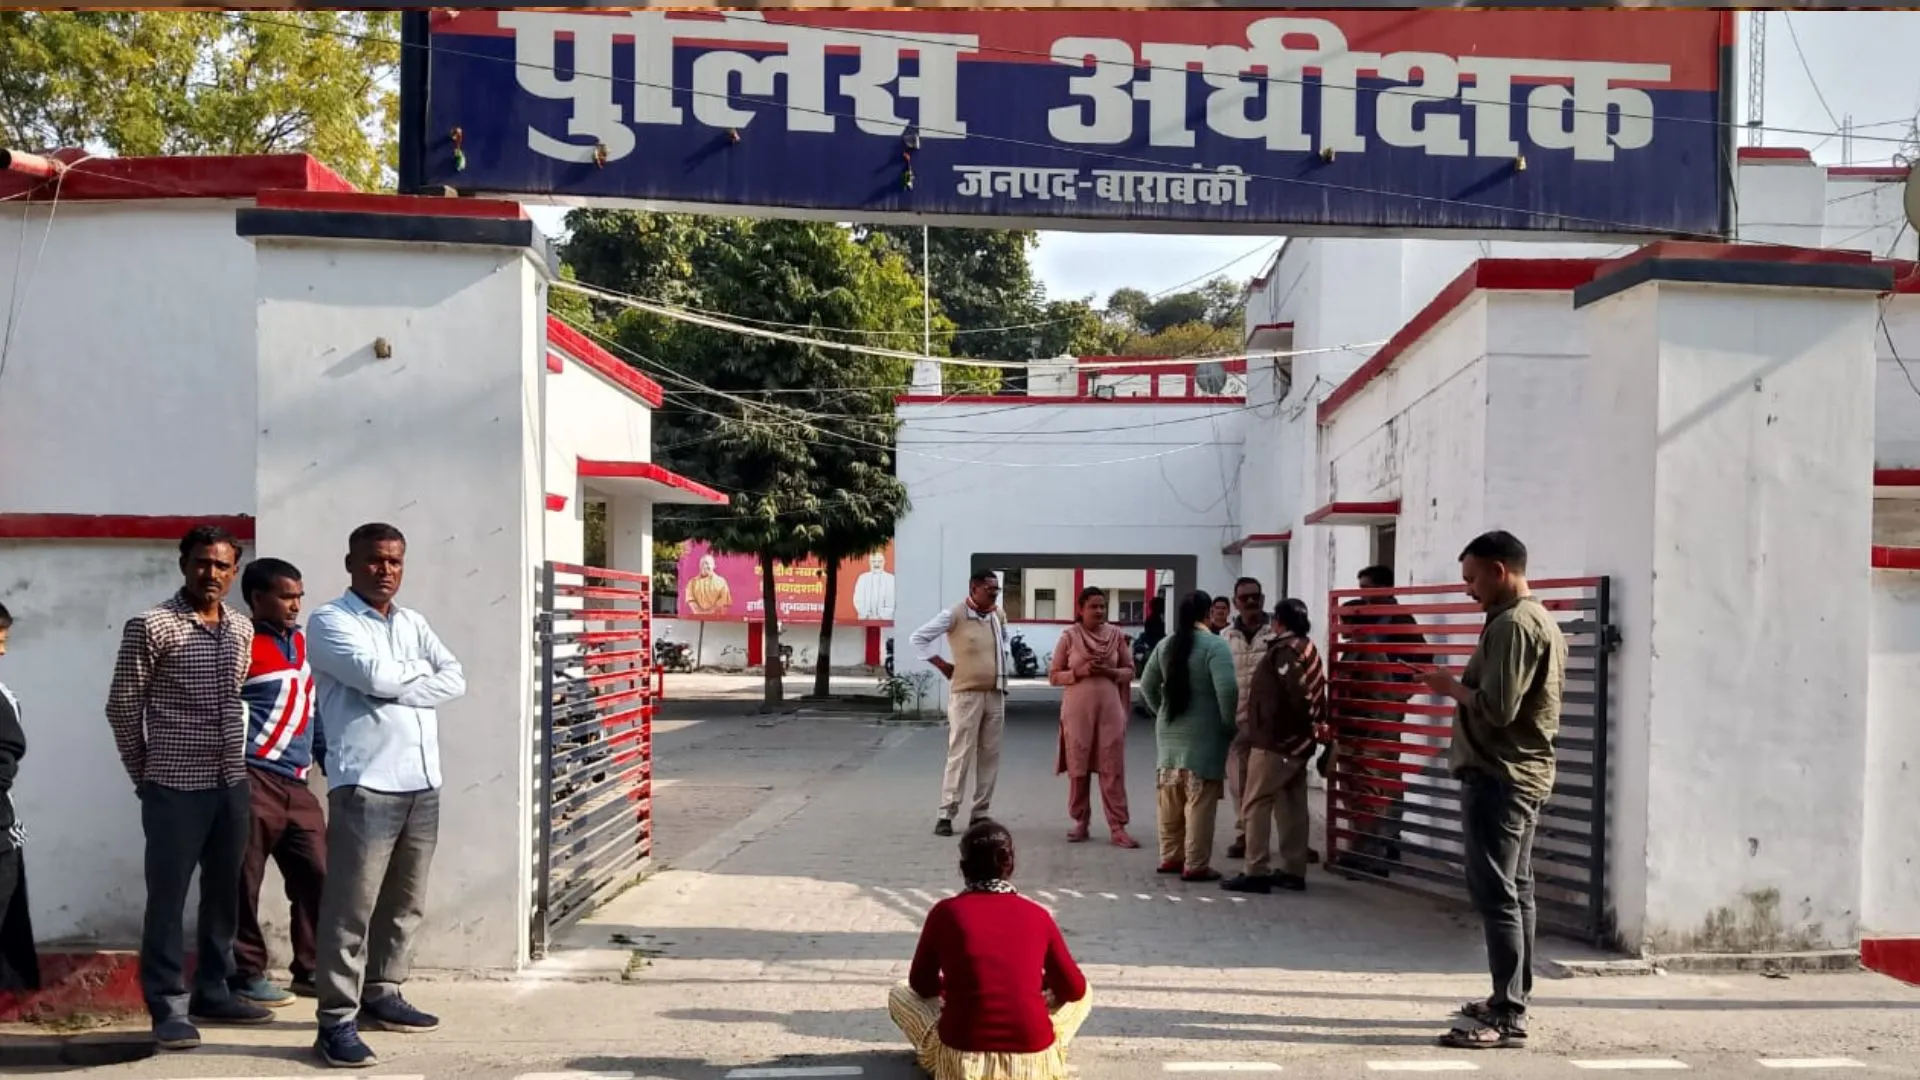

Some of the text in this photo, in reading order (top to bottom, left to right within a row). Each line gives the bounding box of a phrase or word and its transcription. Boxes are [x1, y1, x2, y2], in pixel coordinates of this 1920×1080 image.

[498, 11, 1672, 163] पुलिस अधीक्षक
[952, 162, 1252, 206] जनपद-बाराबंकी
